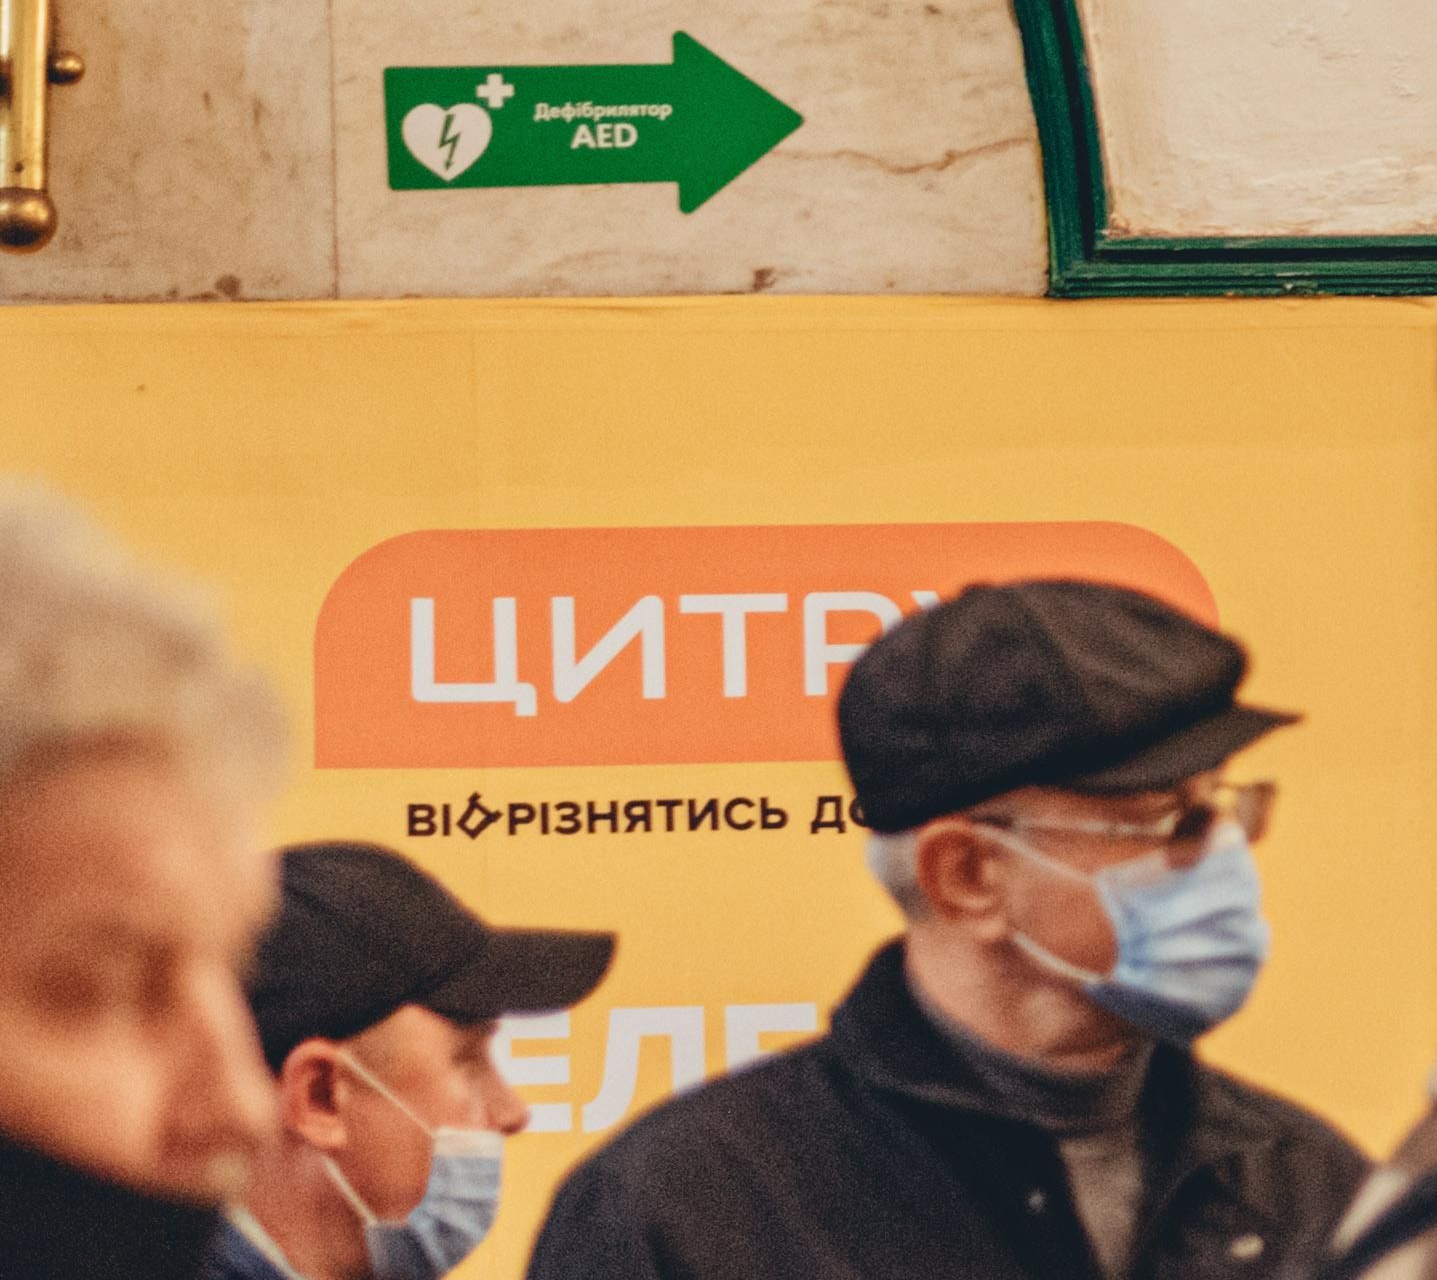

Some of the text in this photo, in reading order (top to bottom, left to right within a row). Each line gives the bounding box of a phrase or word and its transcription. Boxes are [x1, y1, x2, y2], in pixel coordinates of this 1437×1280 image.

[533, 101, 673, 123] Дефібрилятор
[570, 123, 638, 149] AED
[411, 592, 940, 717] ЦИТР
